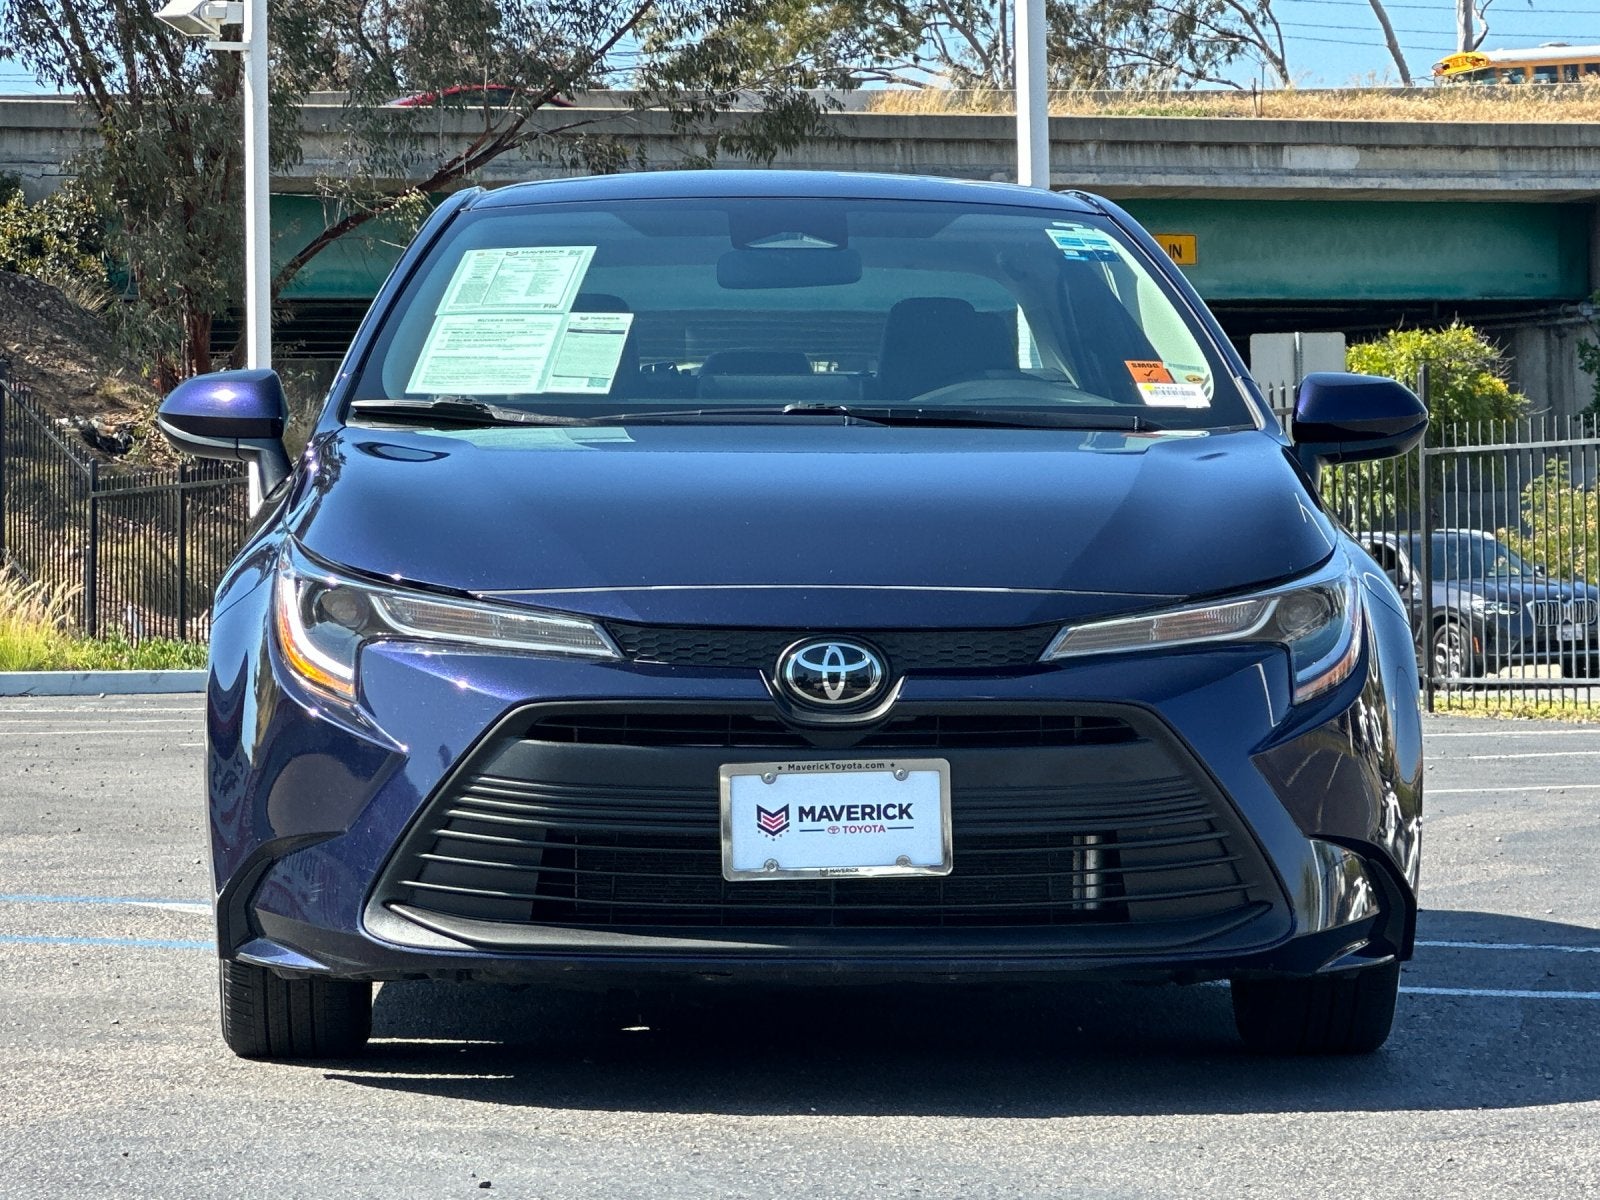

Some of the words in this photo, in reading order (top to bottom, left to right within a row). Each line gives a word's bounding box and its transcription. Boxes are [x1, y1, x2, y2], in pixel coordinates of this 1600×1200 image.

[787, 761, 886, 772] MaverickToyota.com
[798, 802, 914, 823] MAVERICK
[842, 824, 887, 834] TOYOTA
